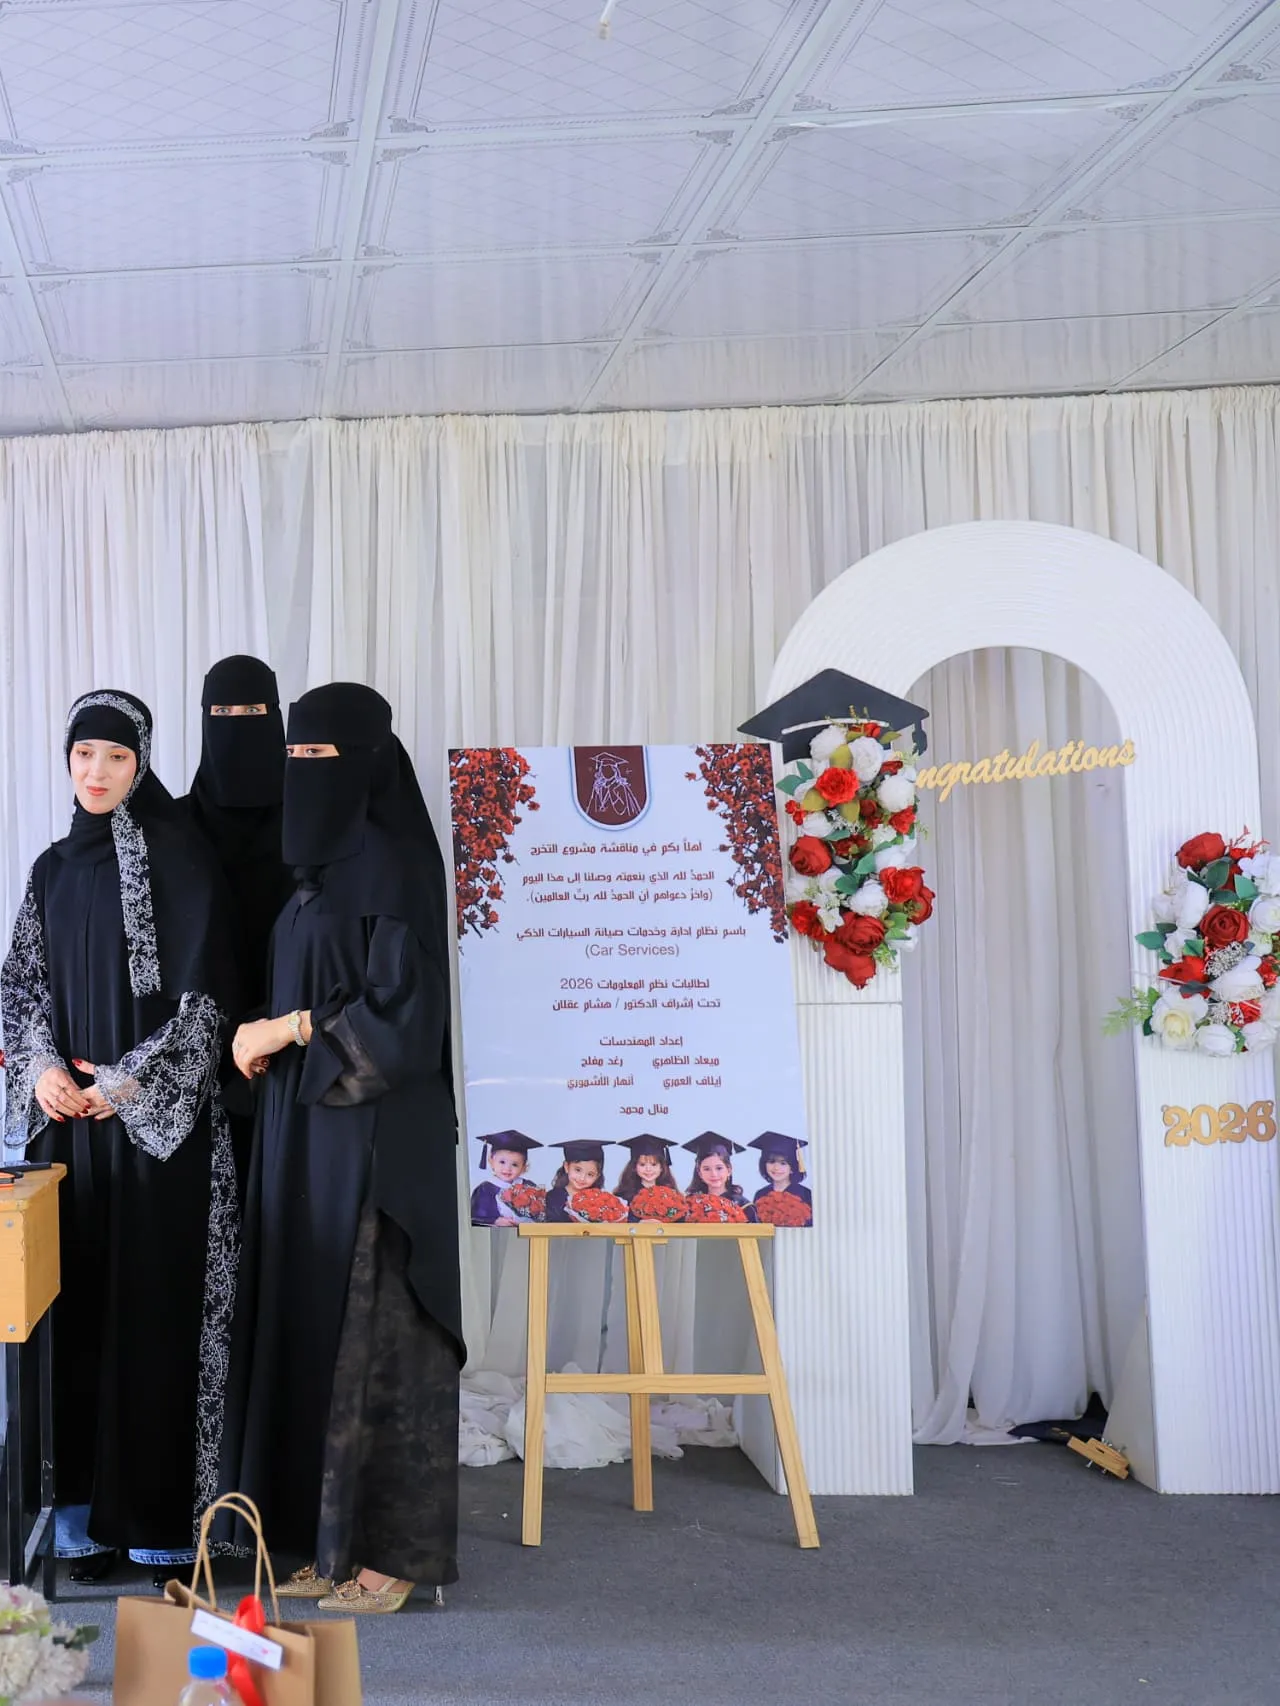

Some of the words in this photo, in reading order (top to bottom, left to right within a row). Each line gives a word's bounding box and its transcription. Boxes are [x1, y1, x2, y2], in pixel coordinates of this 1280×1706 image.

[916, 738, 1135, 802] ngratulations
[530, 844, 558, 856] التخرج
[562, 842, 596, 856] مشروع
[600, 842, 638, 854] مناقشة
[642, 843, 657, 856] في
[661, 843, 680, 856] بكم
[522, 871, 544, 886] اليوم
[547, 872, 564, 882] هذا
[567, 872, 581, 884] إلى
[584, 871, 611, 883] وصلنا
[649, 871, 668, 884] الذي
[673, 871, 686, 880] لله
[593, 891, 607, 901] لله
[653, 889, 687, 903] دعواهم
[516, 928, 545, 942] الذكي
[548, 927, 590, 939] السيارات
[595, 927, 624, 939] صيانة
[627, 926, 666, 938] وخدمات
[696, 926, 718, 940] نظام
[722, 926, 746, 939] باسم
[585, 943, 613, 959] (Car
[618, 943, 680, 958] Services)
[560, 977, 593, 990] 2026
[597, 978, 645, 991] المعلومات
[649, 978, 668, 992] نظم
[672, 978, 710, 990] لطالبات
[552, 999, 579, 1012] عقلان
[583, 998, 612, 1012] هشام
[623, 999, 657, 1011] الدكتور
[661, 998, 694, 1010] إشراف
[697, 998, 721, 1008] تحت
[599, 1036, 655, 1047] المهندسات
[659, 1036, 683, 1047] إعداد
[581, 1056, 604, 1068] مفلح
[607, 1056, 623, 1067] رغد
[652, 1055, 689, 1069] الظاهري
[694, 1056, 720, 1067] ميعاد
[663, 1076, 691, 1090] العمري
[620, 1104, 644, 1115] محمد
[648, 1104, 669, 1115] منال
[1161, 1100, 1276, 1147] 2026
